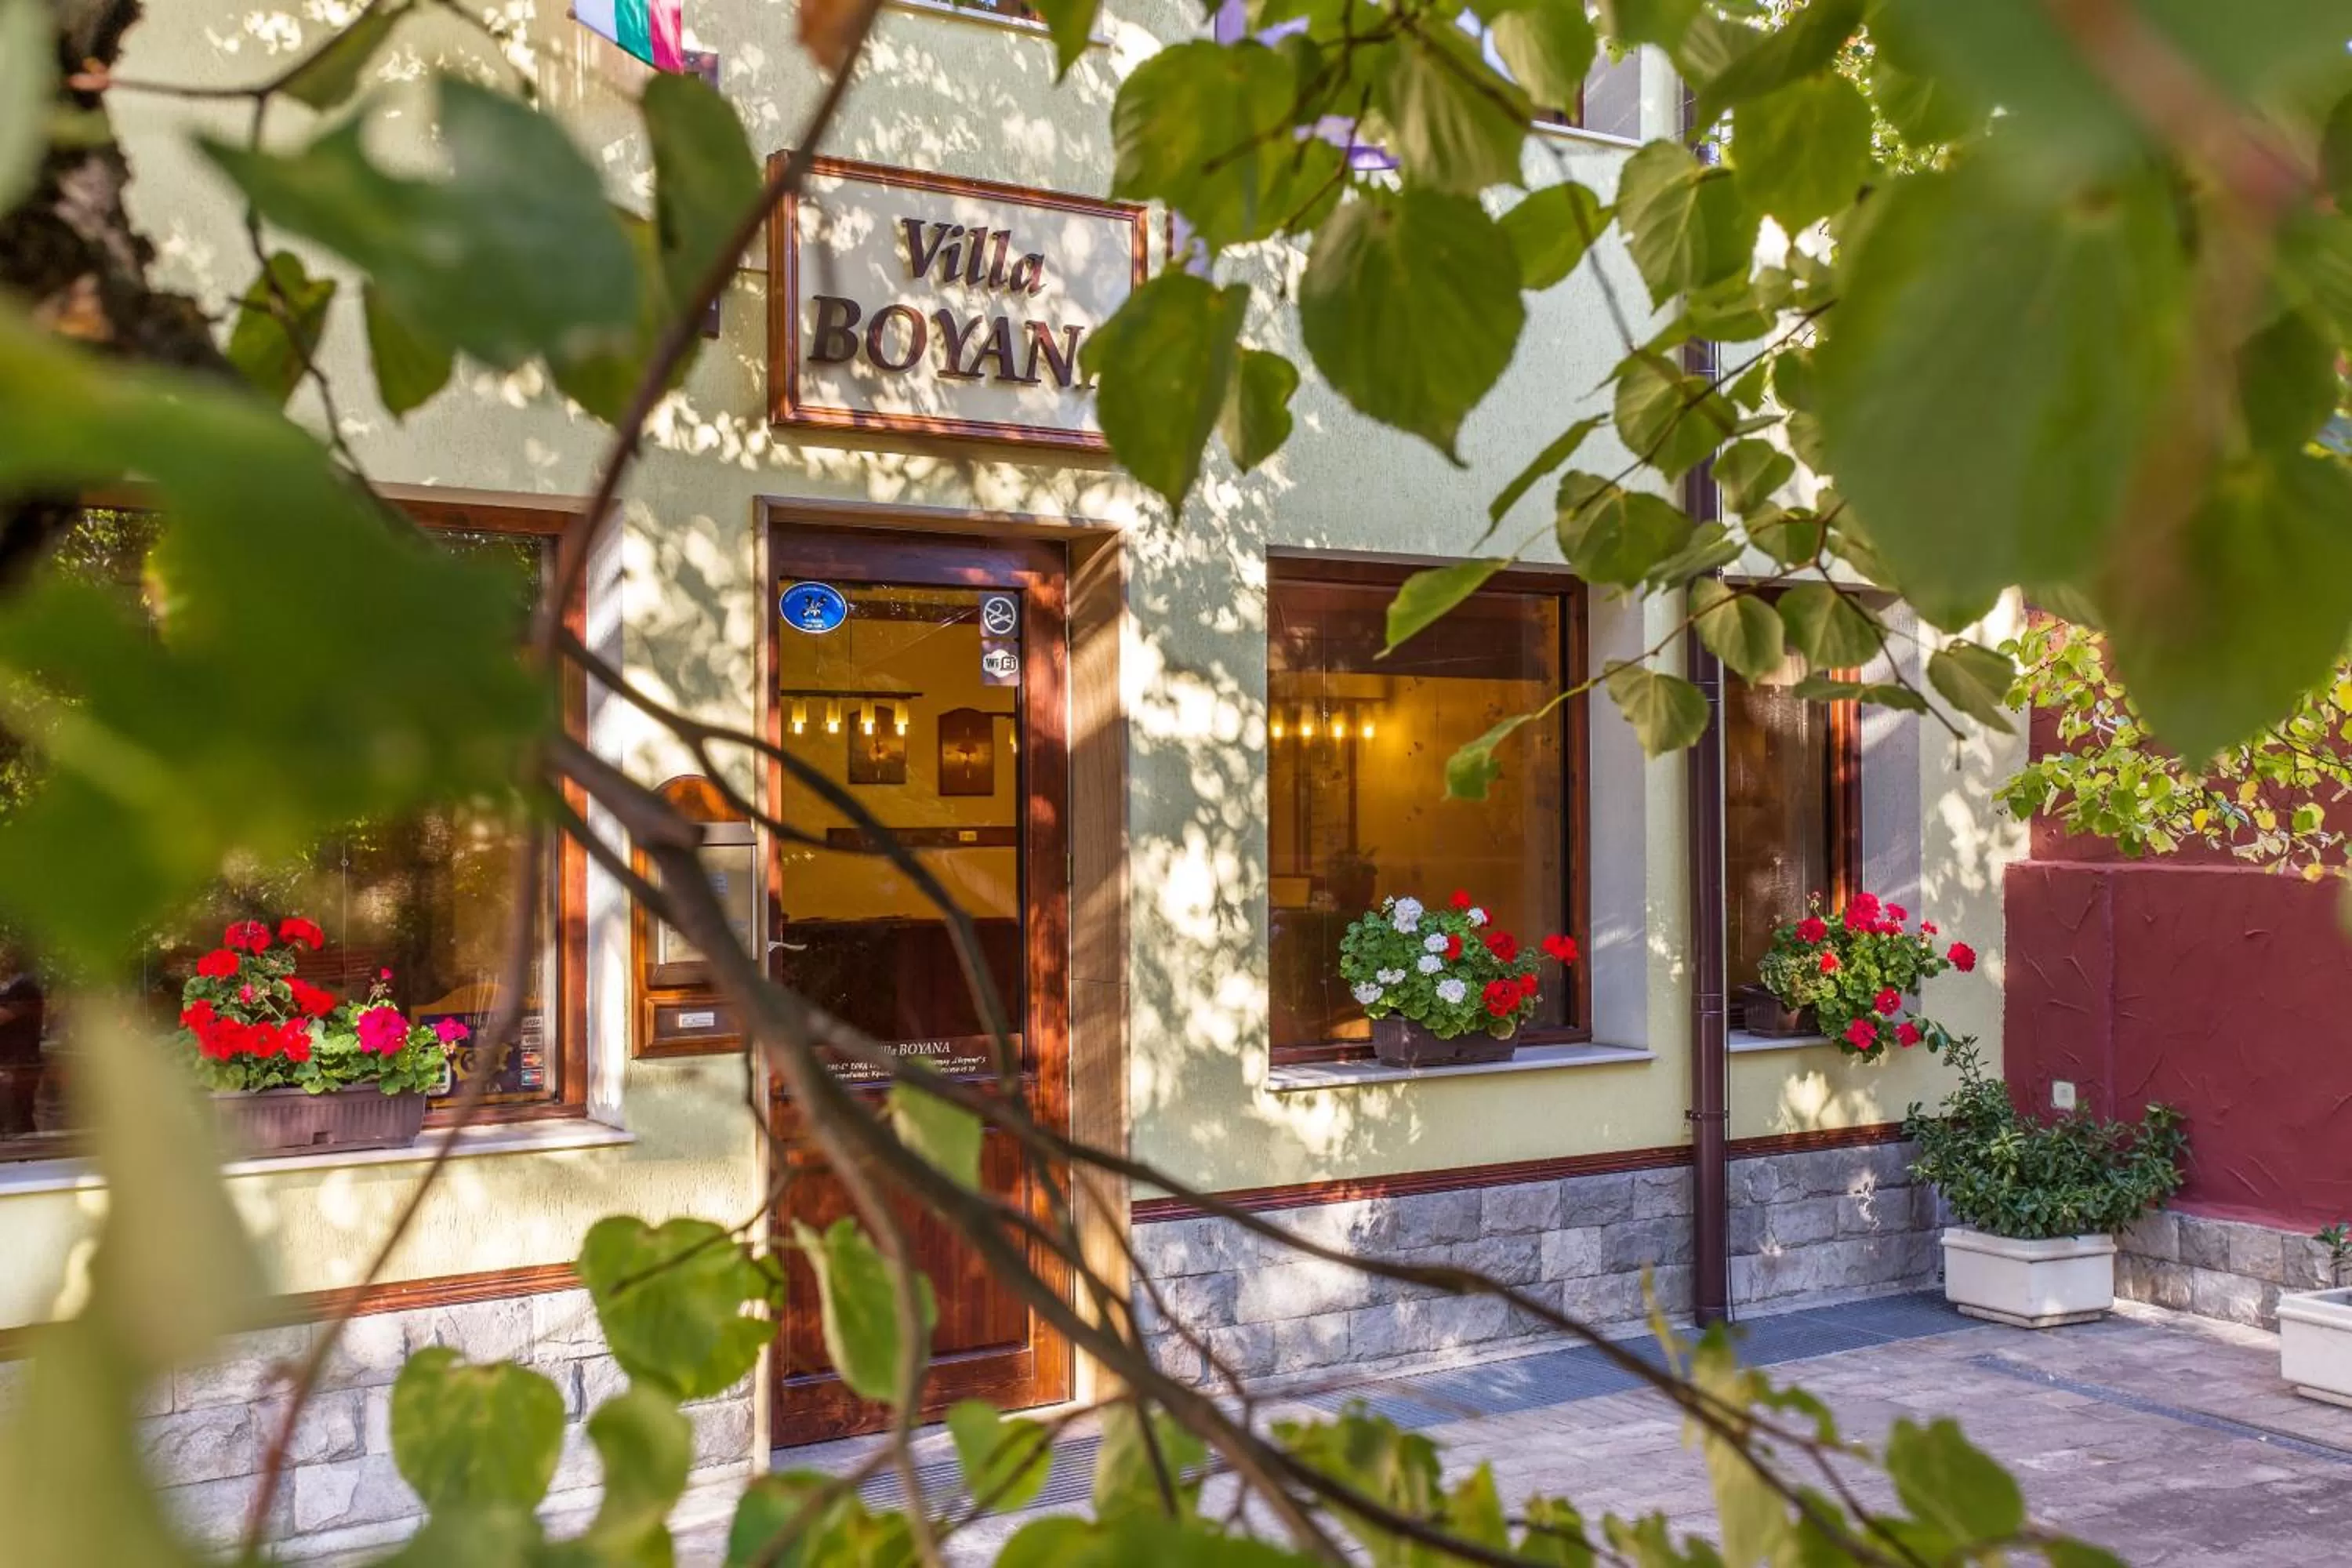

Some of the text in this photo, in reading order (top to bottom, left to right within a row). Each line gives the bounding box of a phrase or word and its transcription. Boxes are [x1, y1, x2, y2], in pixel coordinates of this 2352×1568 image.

[901, 217, 1047, 295] Villa
[808, 295, 1097, 390] BOYAN
[899, 1041, 951, 1055] BOYANA
